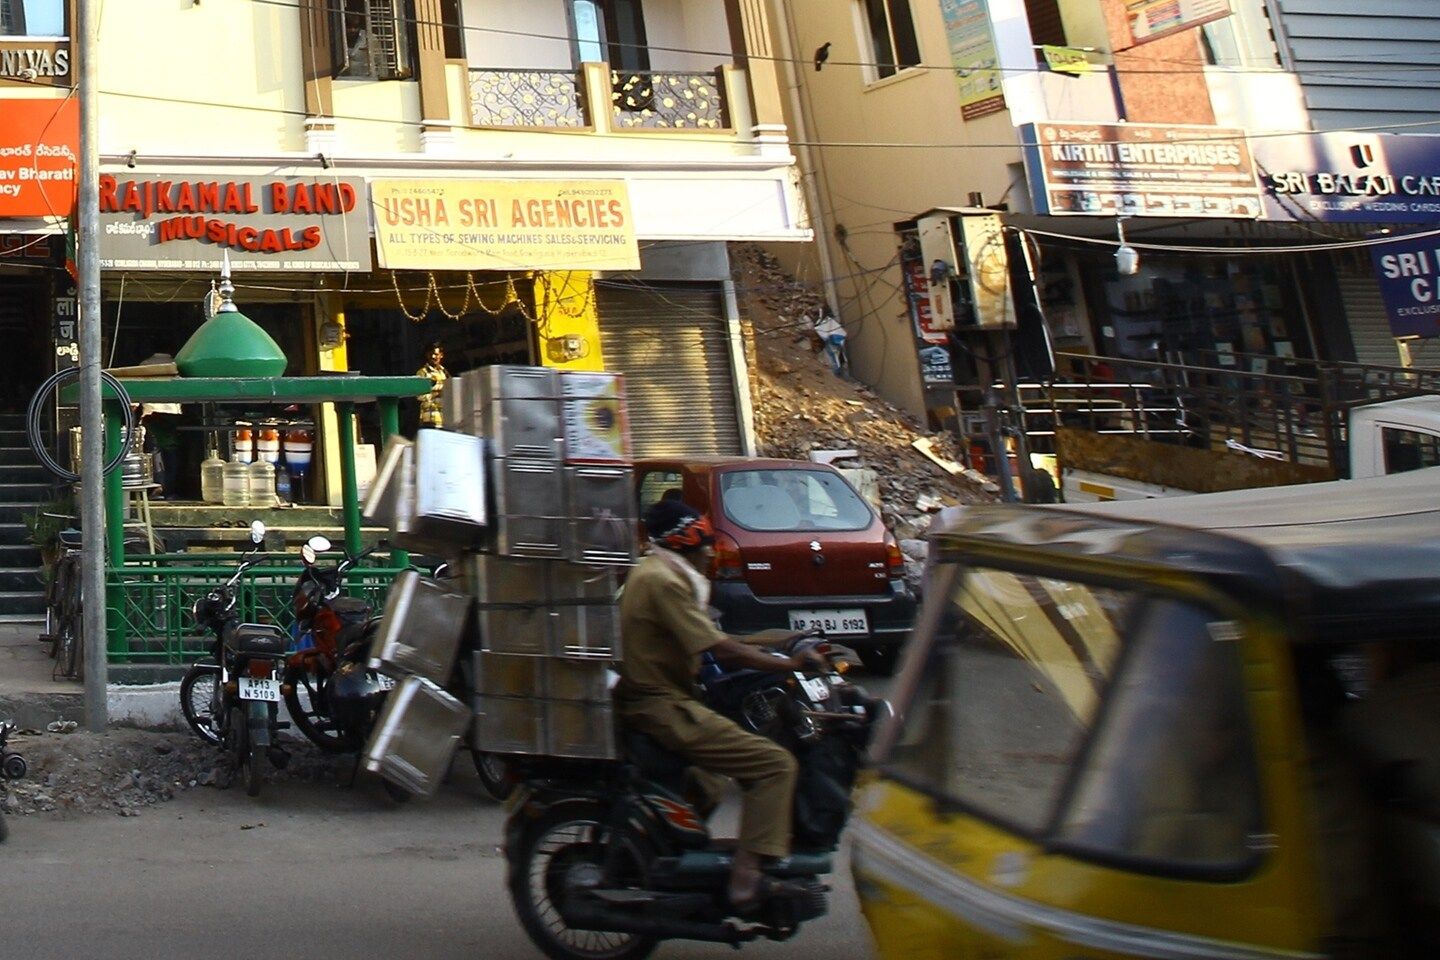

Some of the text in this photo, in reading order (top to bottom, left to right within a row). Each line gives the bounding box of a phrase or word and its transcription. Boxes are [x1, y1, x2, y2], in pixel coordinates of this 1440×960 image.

[0, 49, 69, 77] NIVAS
[1051, 143, 1241, 166] KIRTHI ENTERPRISES
[1272, 172, 1309, 194] SRI
[1317, 173, 1396, 195] BALAJI
[99, 173, 356, 219] RAJKAMAL BAND
[1311, 201, 1360, 210] EXCLUSIVE
[1364, 202, 1407, 212] WEDDING
[384, 197, 624, 228] USHA SRI AGENCIES
[160, 215, 321, 253] MUSICALS
[389, 233, 406, 244] ALL
[409, 233, 441, 244] TYPES
[443, 233, 455, 244] OF
[459, 233, 495, 244] SEWING
[497, 234, 543, 244] MACHINES
[1381, 251, 1430, 279] SRI
[794, 619, 865, 630] AP 29 BJ 6192
[244, 690, 275, 699] N 5109
[248, 679, 270, 689] AP13
